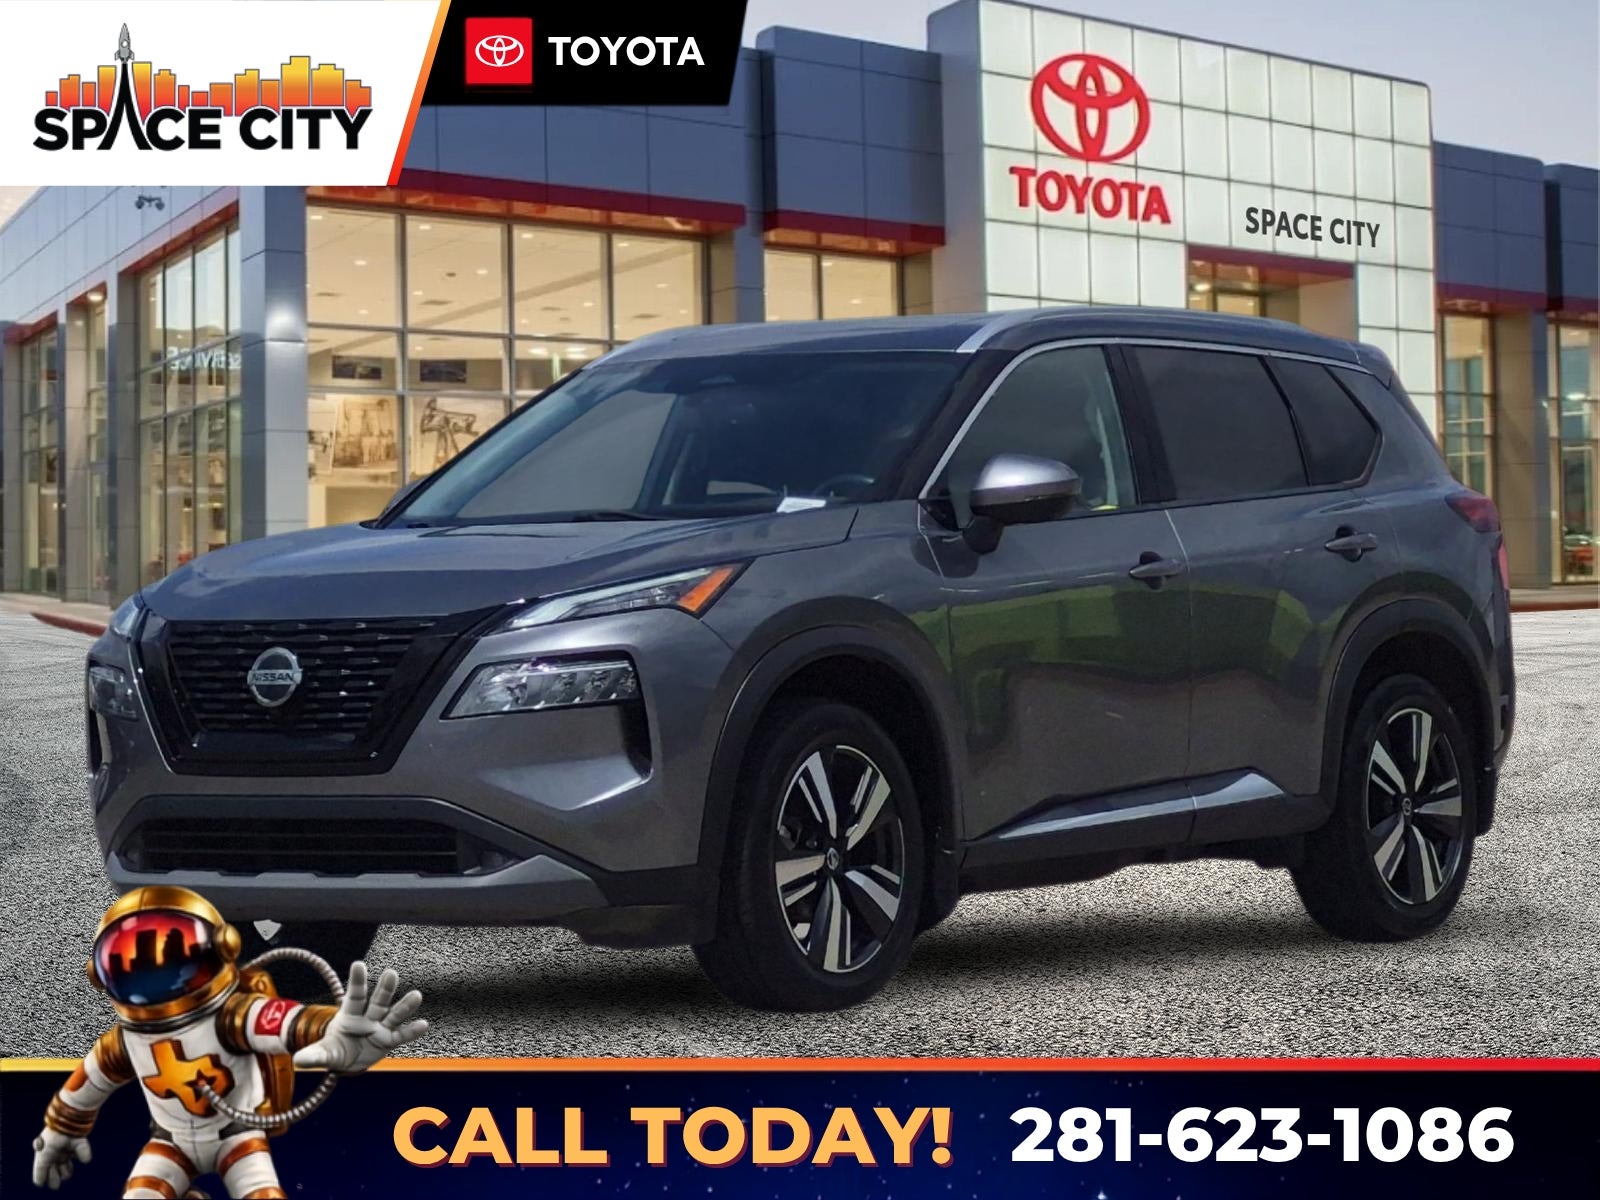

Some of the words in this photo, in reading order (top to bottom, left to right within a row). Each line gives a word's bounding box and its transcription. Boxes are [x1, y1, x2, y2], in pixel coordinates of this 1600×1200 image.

[1009, 166, 1171, 224] TOYOTA
[1245, 207, 1322, 242] SPACE
[1330, 218, 1381, 248] CITY
[251, 672, 295, 682] NISSAN
